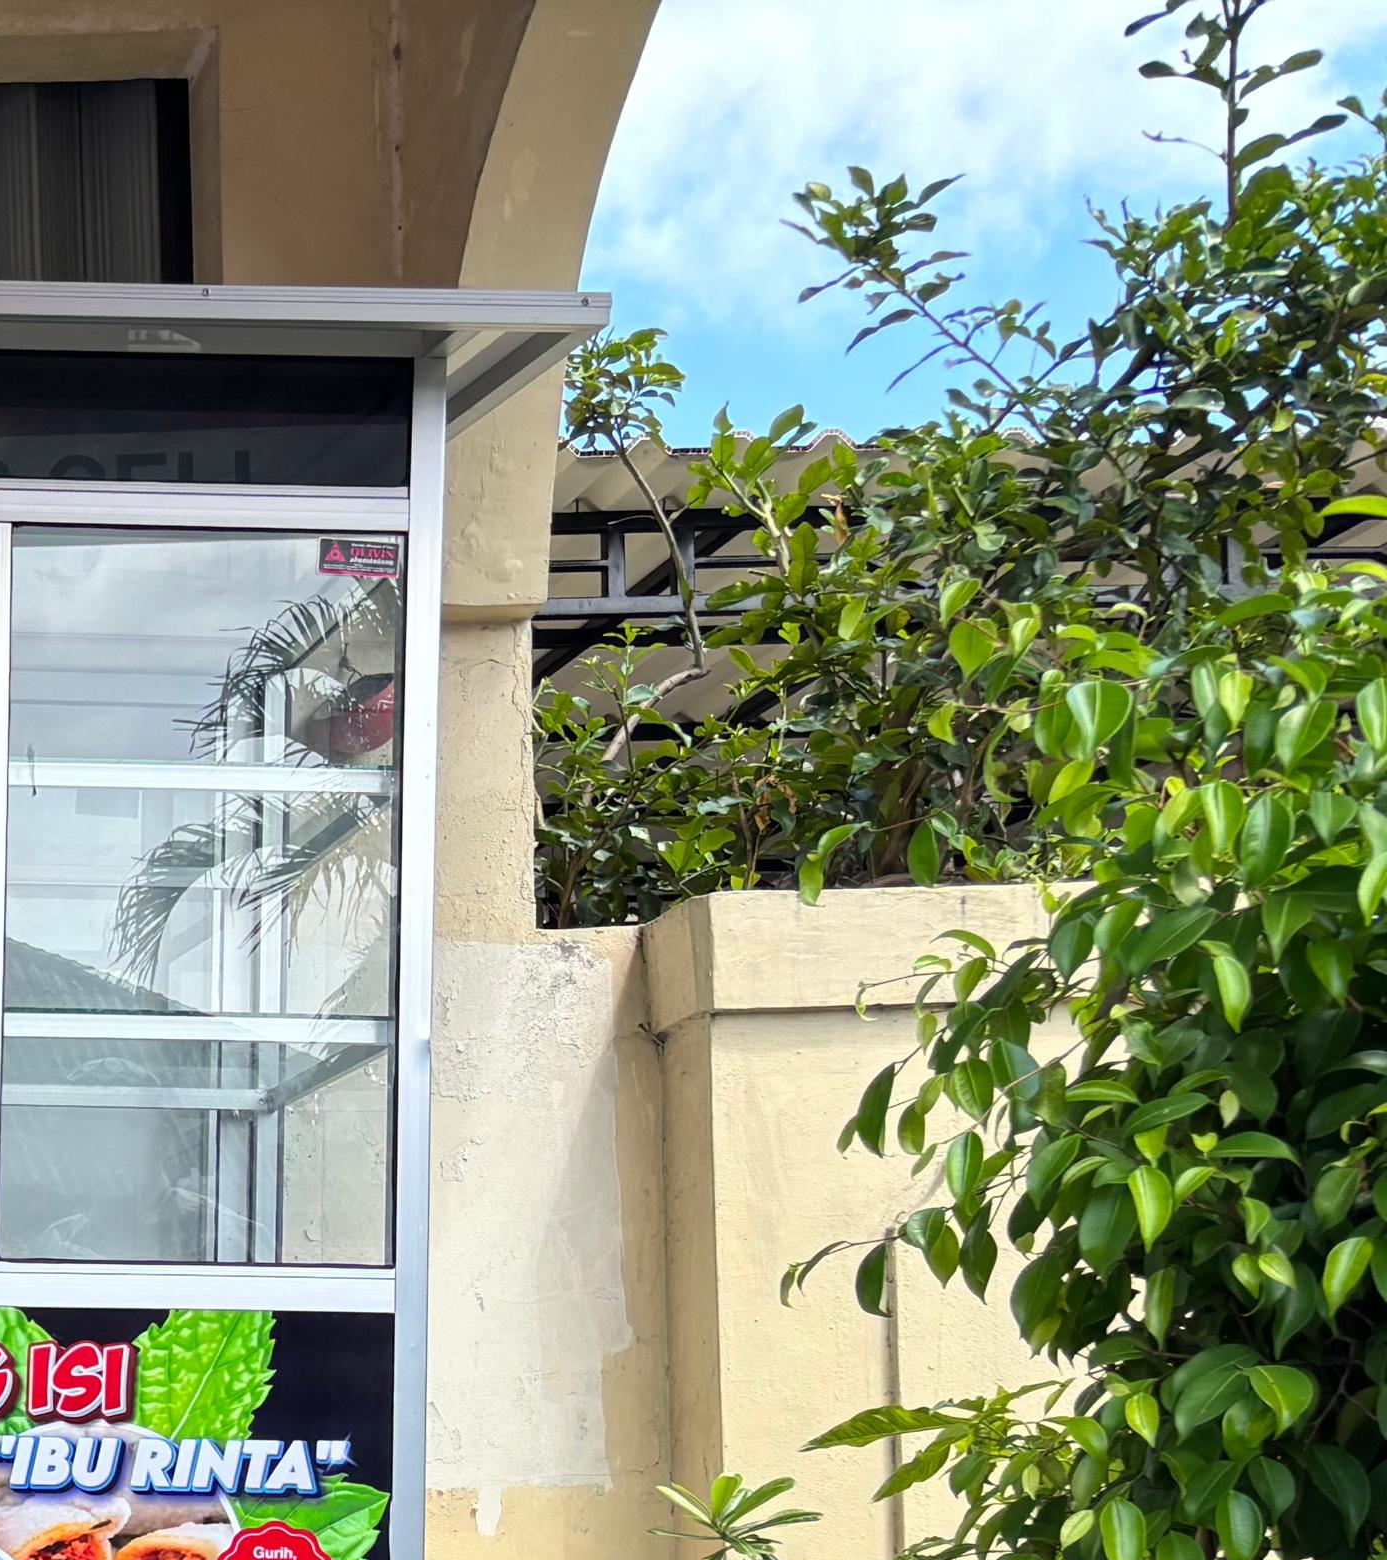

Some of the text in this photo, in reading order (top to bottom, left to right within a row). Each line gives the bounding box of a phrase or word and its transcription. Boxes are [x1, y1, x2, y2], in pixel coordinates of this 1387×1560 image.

[27, 1340, 138, 1420] ISI
[129, 1437, 351, 1495] RINTA"
[253, 1546, 297, 1560] Gurih,
